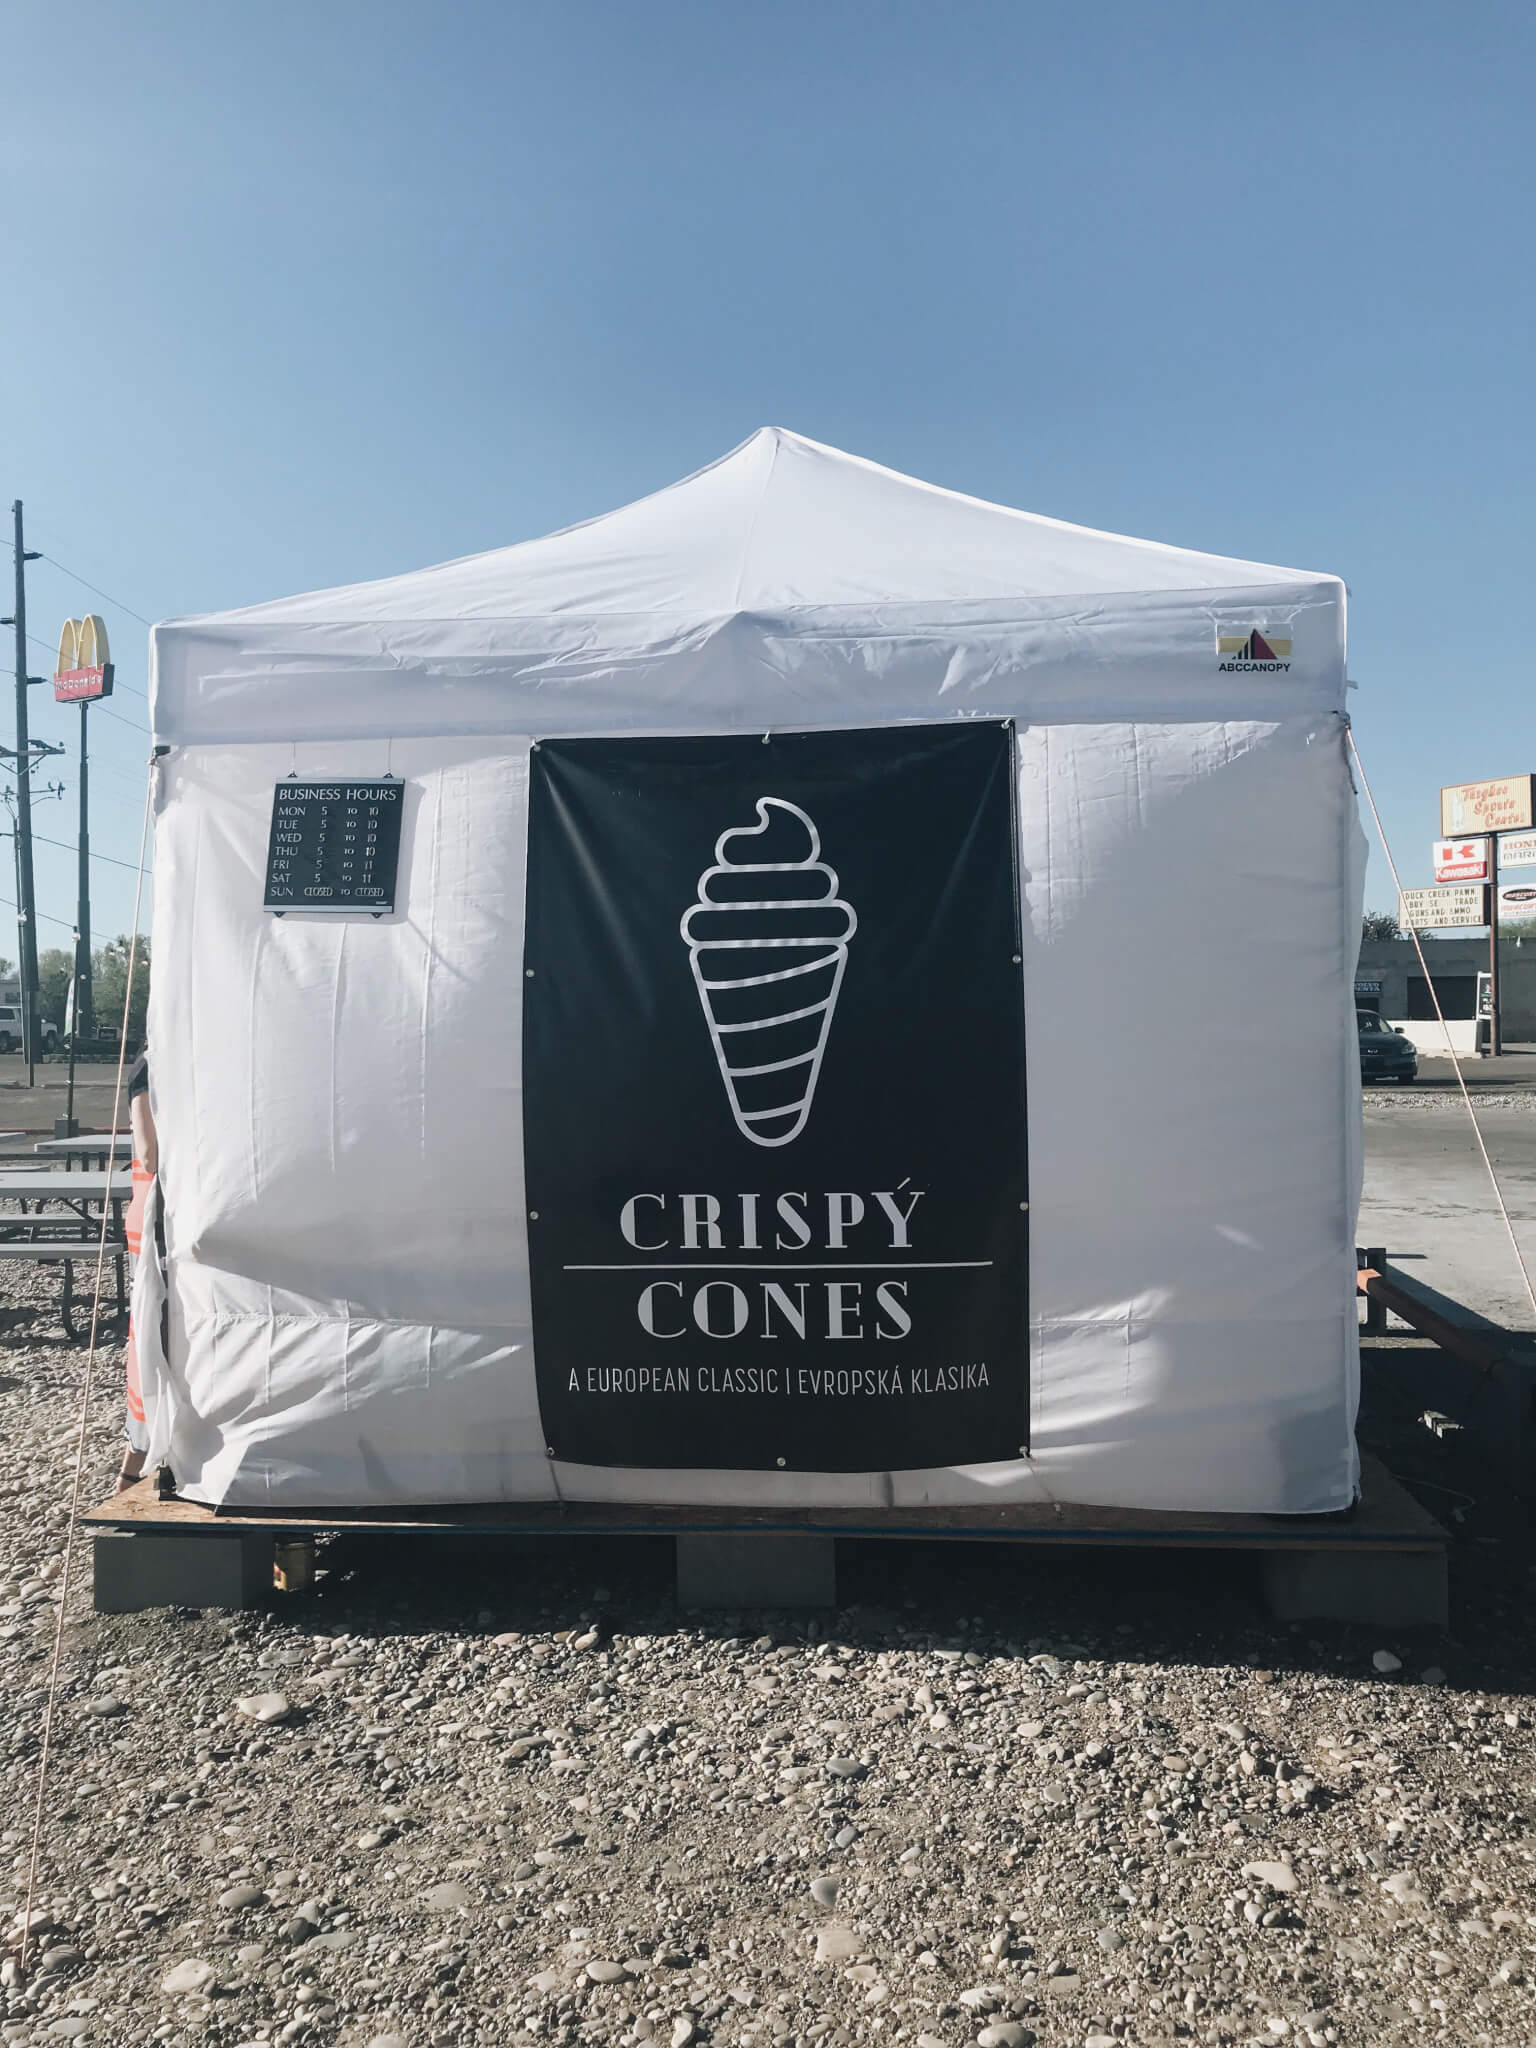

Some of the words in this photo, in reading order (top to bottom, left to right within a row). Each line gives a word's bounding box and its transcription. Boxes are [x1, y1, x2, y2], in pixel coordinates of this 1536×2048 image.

[1219, 663, 1291, 672] ABCCANOPY
[279, 788, 341, 800] BUSINESS
[346, 788, 397, 801] HOURS
[278, 807, 306, 816] MON
[321, 806, 328, 816] 5
[368, 807, 379, 816] 10
[278, 820, 299, 829] TUE
[320, 819, 327, 829] 5
[367, 820, 378, 829] 10
[276, 833, 302, 843] WED
[319, 833, 325, 842] 5
[367, 833, 377, 843] 10
[275, 847, 298, 856] THU
[317, 846, 323, 856] 5
[365, 846, 376, 857] 10
[273, 860, 290, 869] FRI
[316, 859, 322, 869] 5
[365, 860, 373, 870] 11
[271, 873, 291, 883] SAT
[314, 873, 321, 883] 5
[362, 874, 372, 883] 11
[271, 887, 294, 897] SUN
[304, 887, 333, 897] CLOSED
[355, 887, 384, 897] CLOSED
[1406, 892, 1424, 900] DUCK
[1428, 890, 1450, 899] CREEK
[1455, 888, 1475, 896] PAWN
[1455, 897, 1479, 905] TRADE
[1410, 909, 1429, 917] GUNS
[1432, 908, 1445, 916] AND
[1452, 915, 1481, 924] SERVICE
[620, 1177, 925, 1250] CRISPÝ
[637, 1281, 912, 1340] CONES
[569, 1367, 580, 1392] A
[587, 1367, 690, 1392] EUROPEAN
[698, 1368, 778, 1393] CLASSIC
[799, 1365, 903, 1396] EVROPSKÁ
[911, 1363, 989, 1394] KLASIKA
